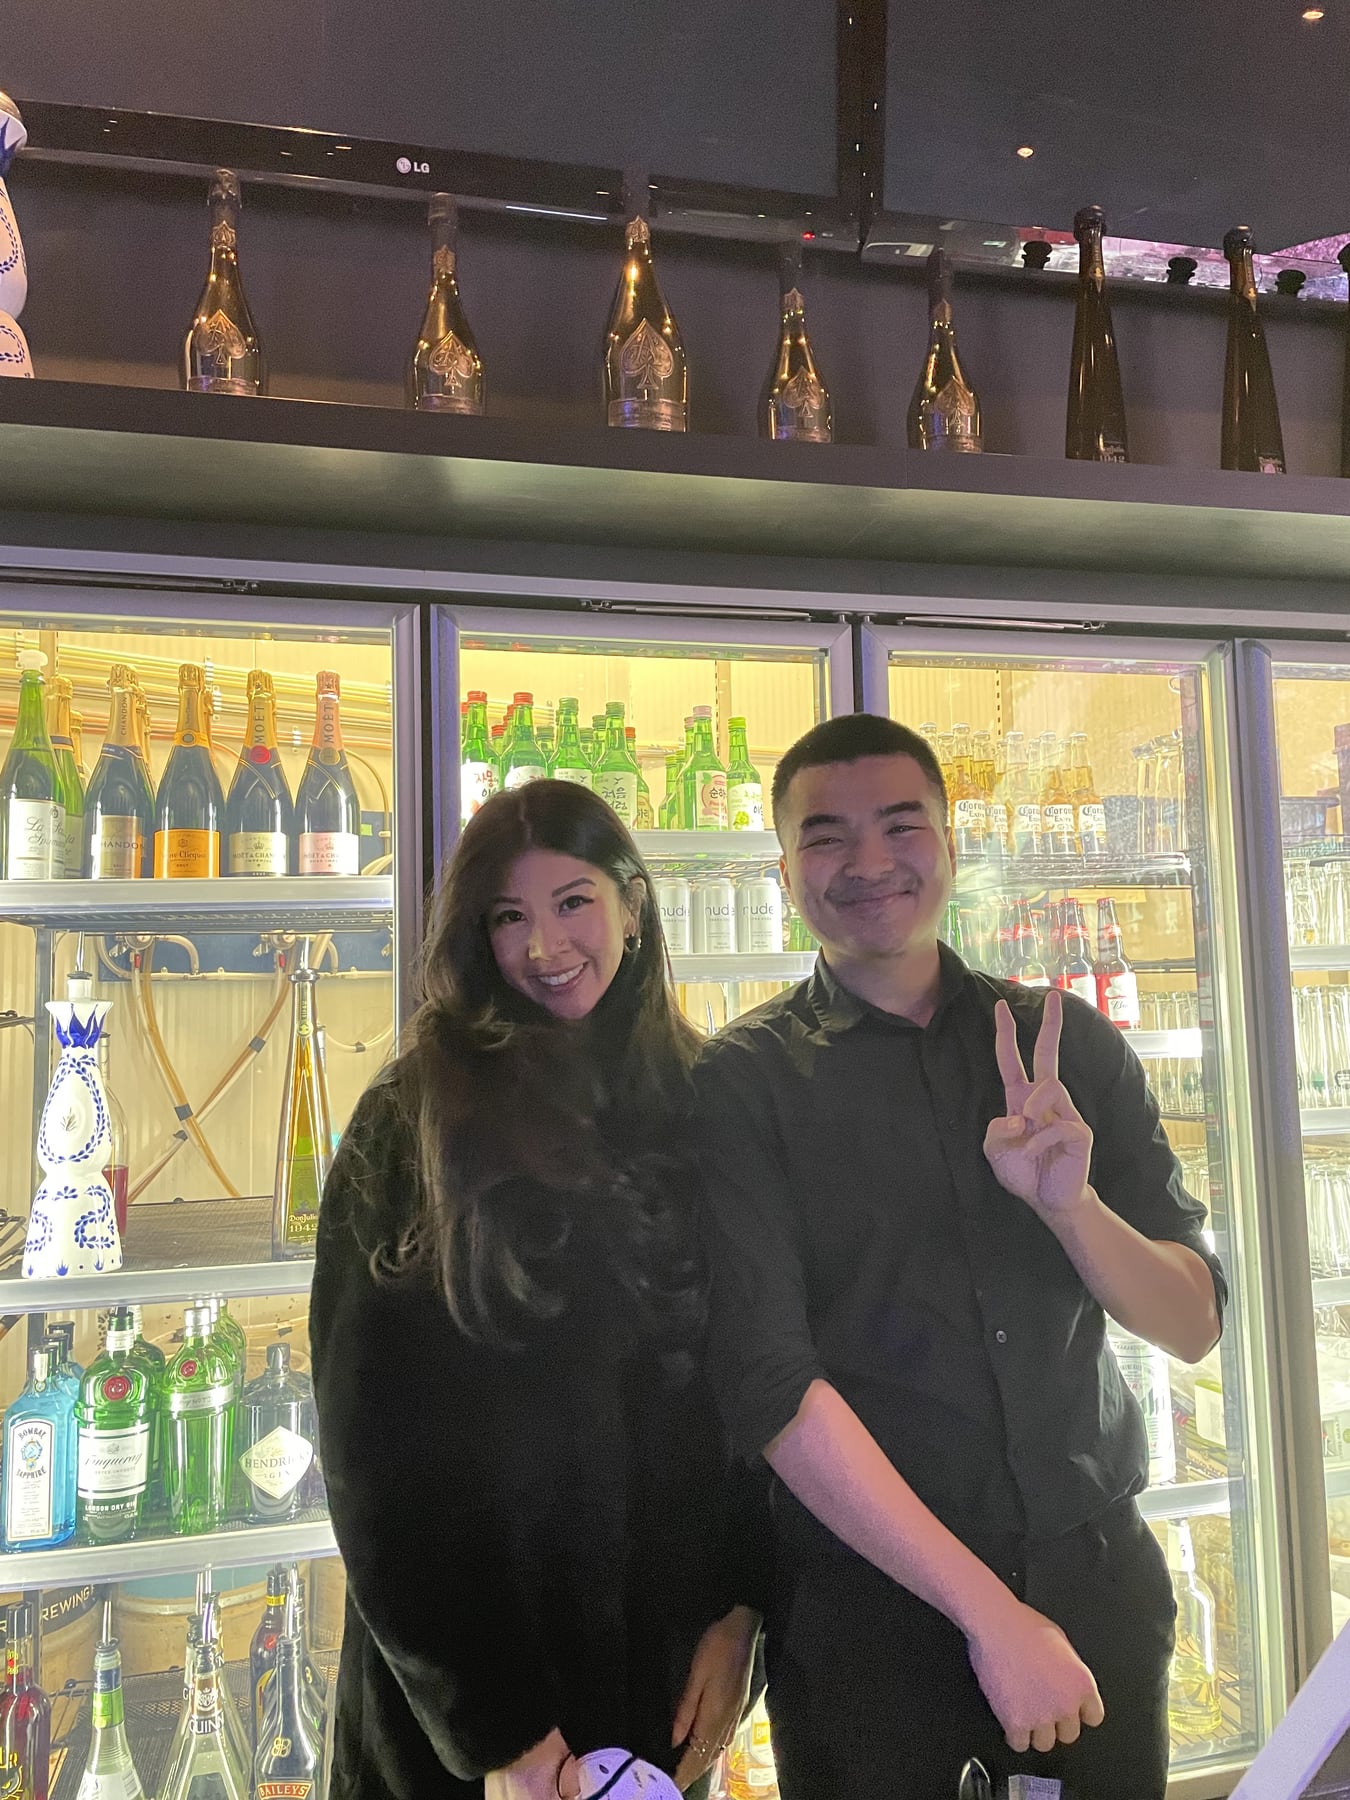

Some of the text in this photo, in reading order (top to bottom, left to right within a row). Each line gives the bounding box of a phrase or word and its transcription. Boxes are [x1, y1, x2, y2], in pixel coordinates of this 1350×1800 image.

[413, 161, 430, 173] LG
[121, 695, 129, 736] CHANDON
[602, 786, 629, 799] 처음
[743, 903, 774, 915] nude
[18, 1427, 47, 1440] BOMBAY
[16, 1466, 47, 1480] SAPPHIRE
[111, 1503, 123, 1511] DRY
[260, 1784, 306, 1796] BAILEYS
